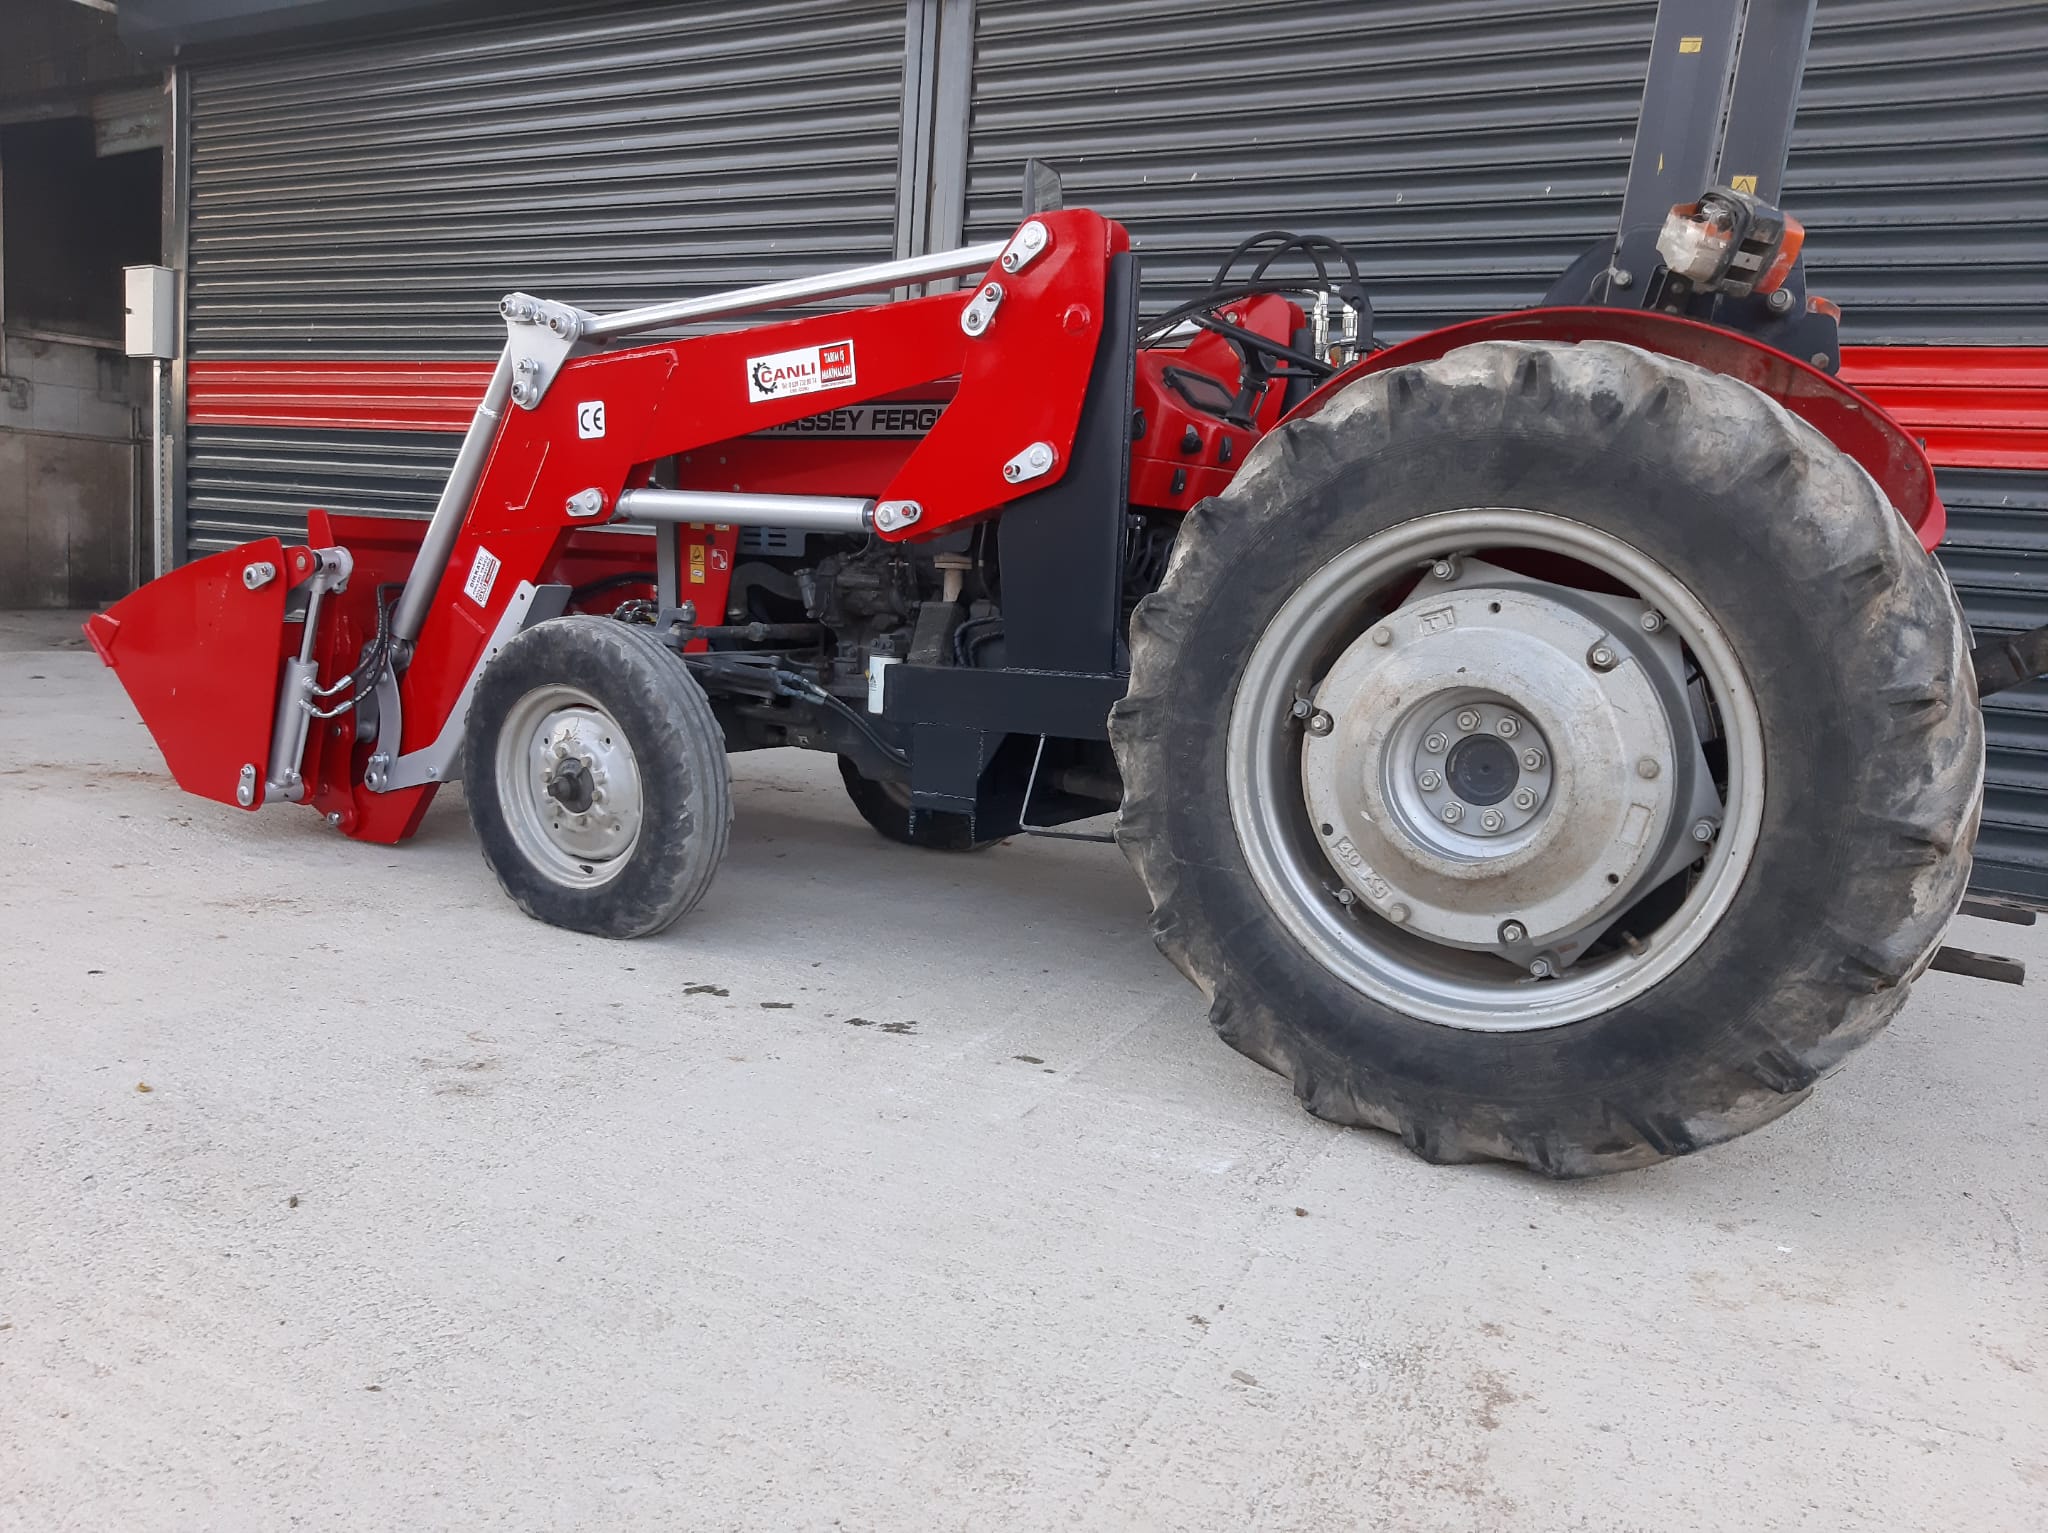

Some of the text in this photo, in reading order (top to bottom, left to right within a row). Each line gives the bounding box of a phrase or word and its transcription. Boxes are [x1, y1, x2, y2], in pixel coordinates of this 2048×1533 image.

[761, 362, 815, 383] CANLI
[580, 407, 603, 432] CE
[770, 408, 942, 431] SSEY FERG
